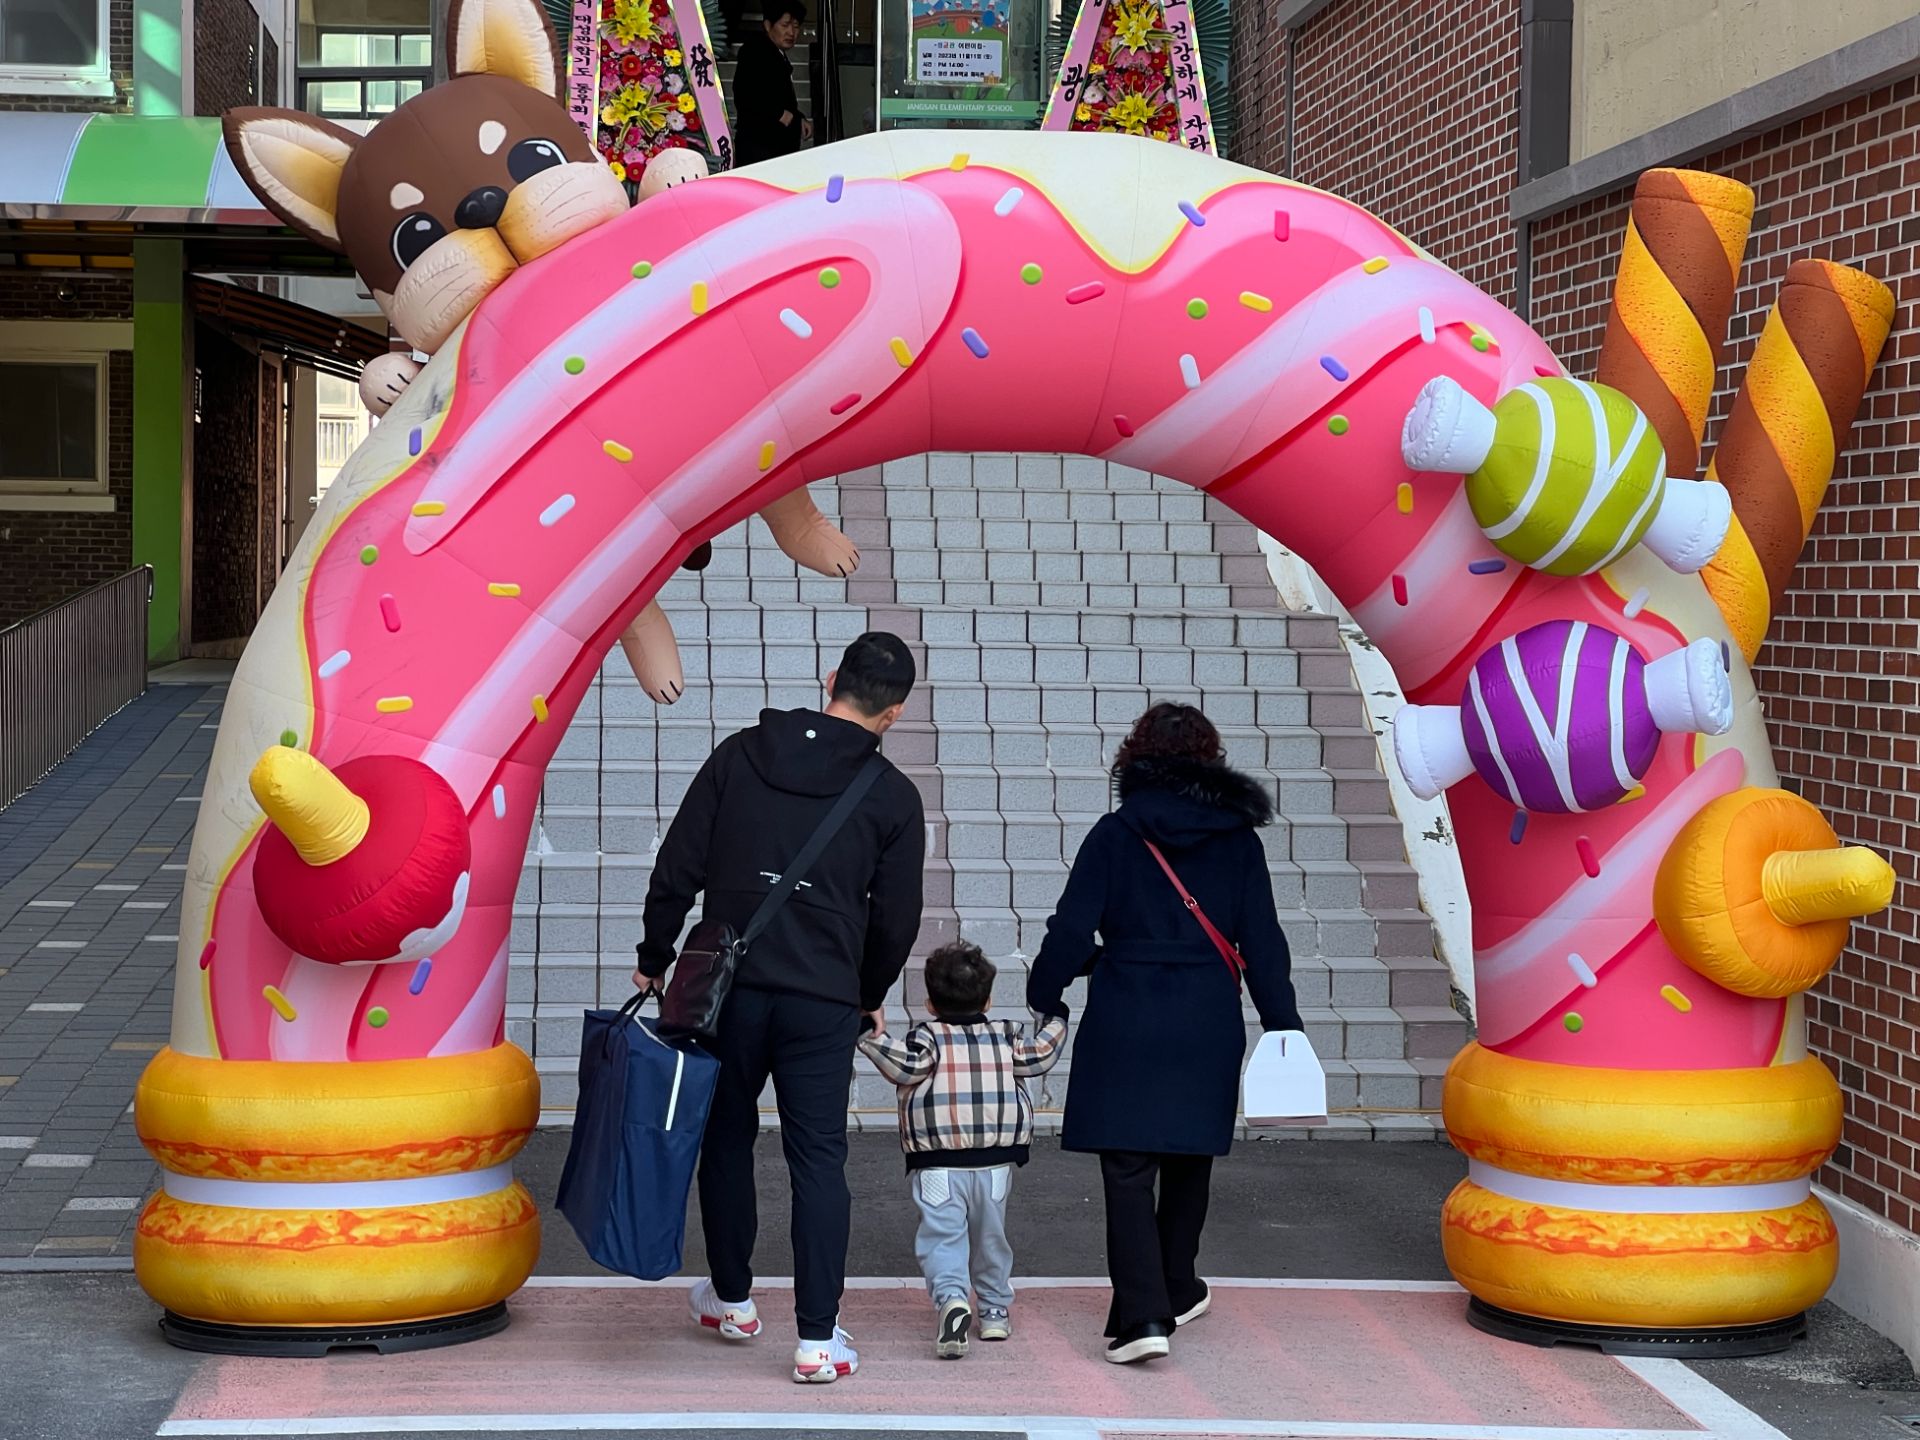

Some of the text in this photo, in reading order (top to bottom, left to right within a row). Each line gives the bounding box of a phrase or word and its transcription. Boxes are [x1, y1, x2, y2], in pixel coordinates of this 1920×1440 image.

[1170, 21, 1199, 103] 건강하게
[907, 103, 1014, 112] JANGSAN ELEMENTARY SCHOOL
